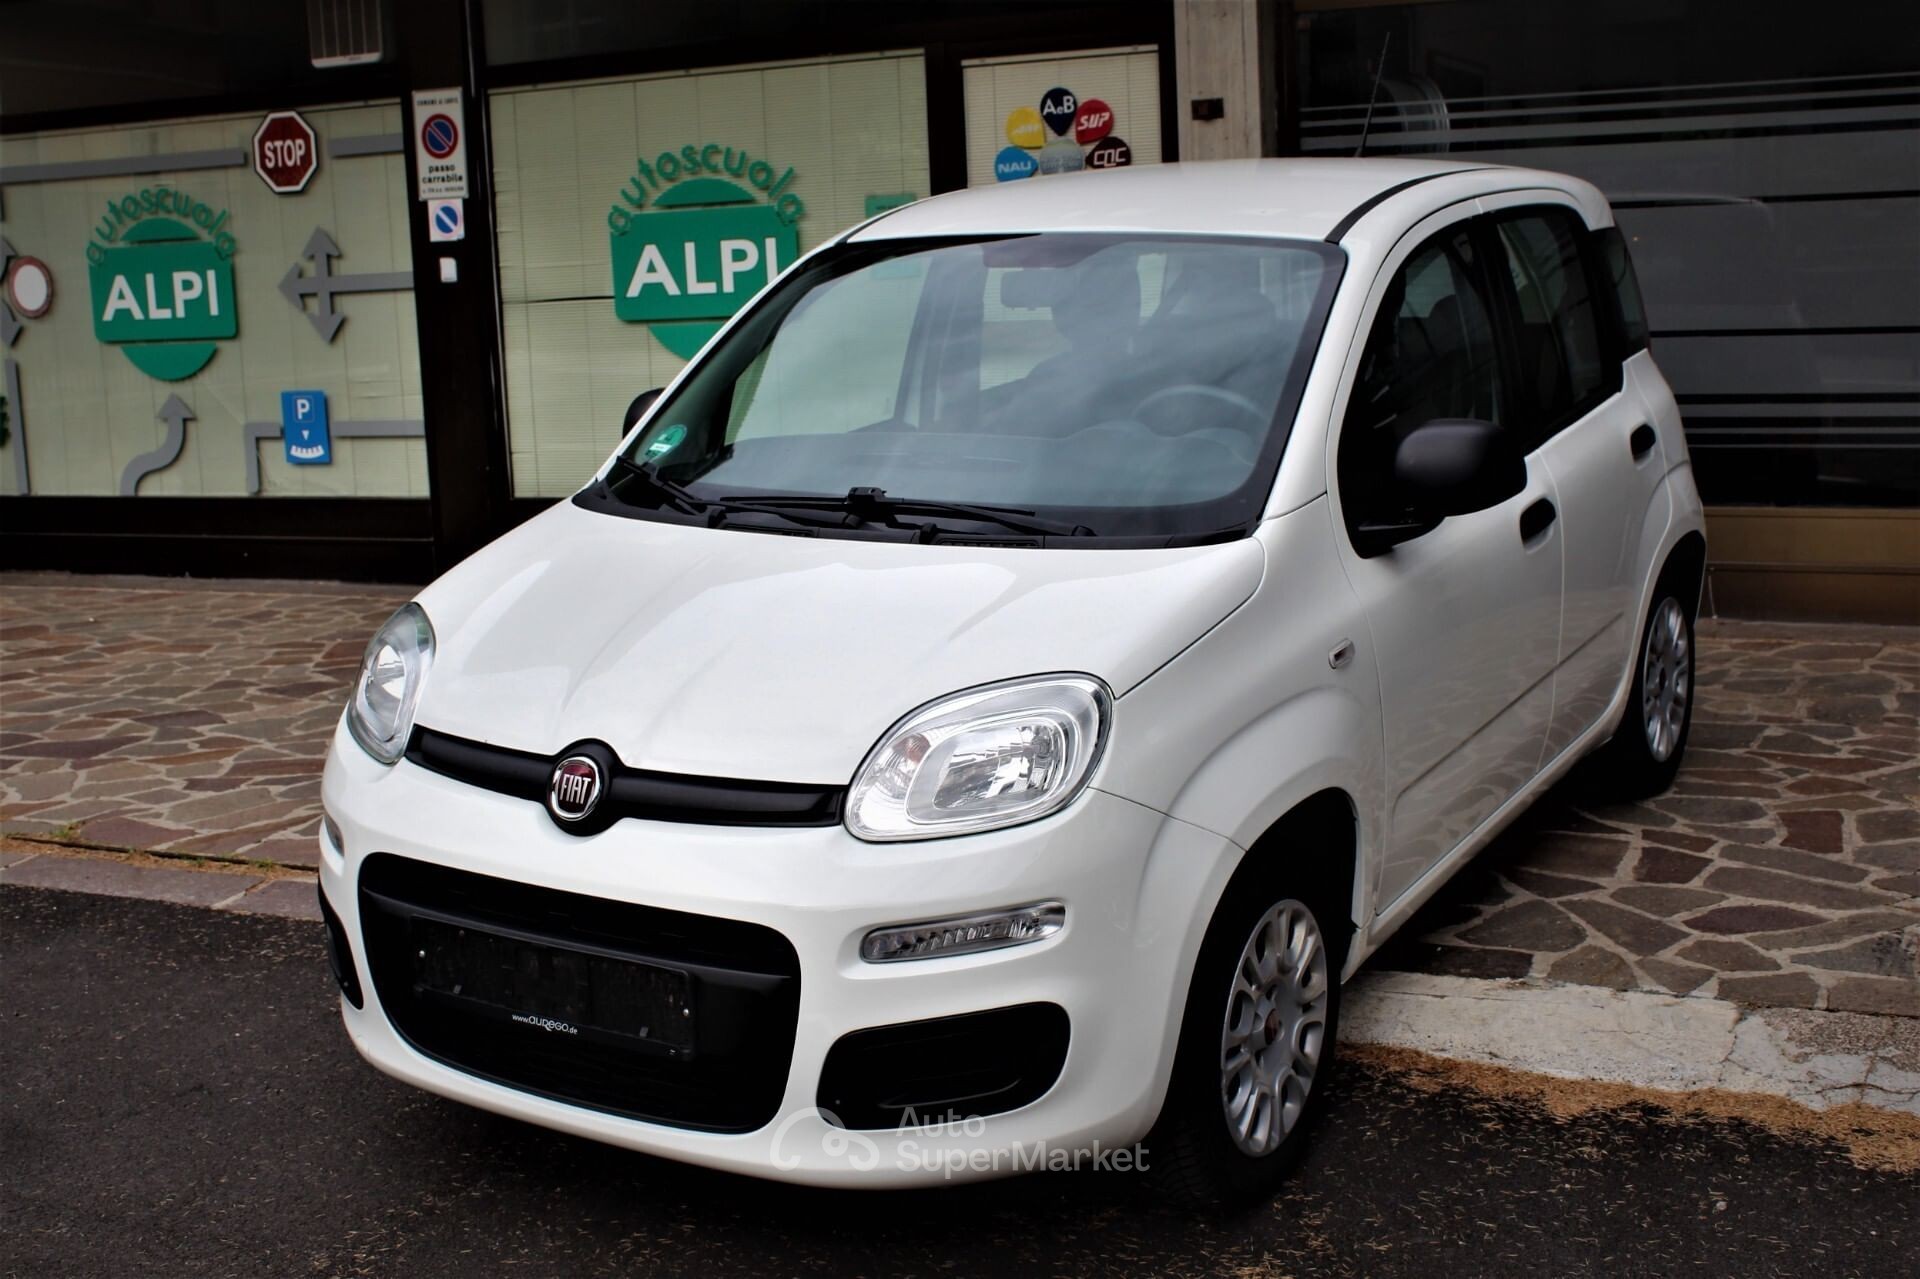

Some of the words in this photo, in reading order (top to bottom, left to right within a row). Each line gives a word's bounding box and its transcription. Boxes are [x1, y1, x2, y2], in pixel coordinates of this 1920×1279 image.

[1077, 111, 1110, 131] SUP
[264, 138, 306, 169] STOP
[428, 163, 456, 175] passo
[422, 173, 463, 185] carrabile
[608, 143, 806, 236] autoscuola
[86, 188, 237, 267] autoscuola
[625, 237, 780, 298] ALPI
[102, 269, 220, 322] ALPI
[296, 399, 310, 420] P
[560, 773, 592, 805] FIAT
